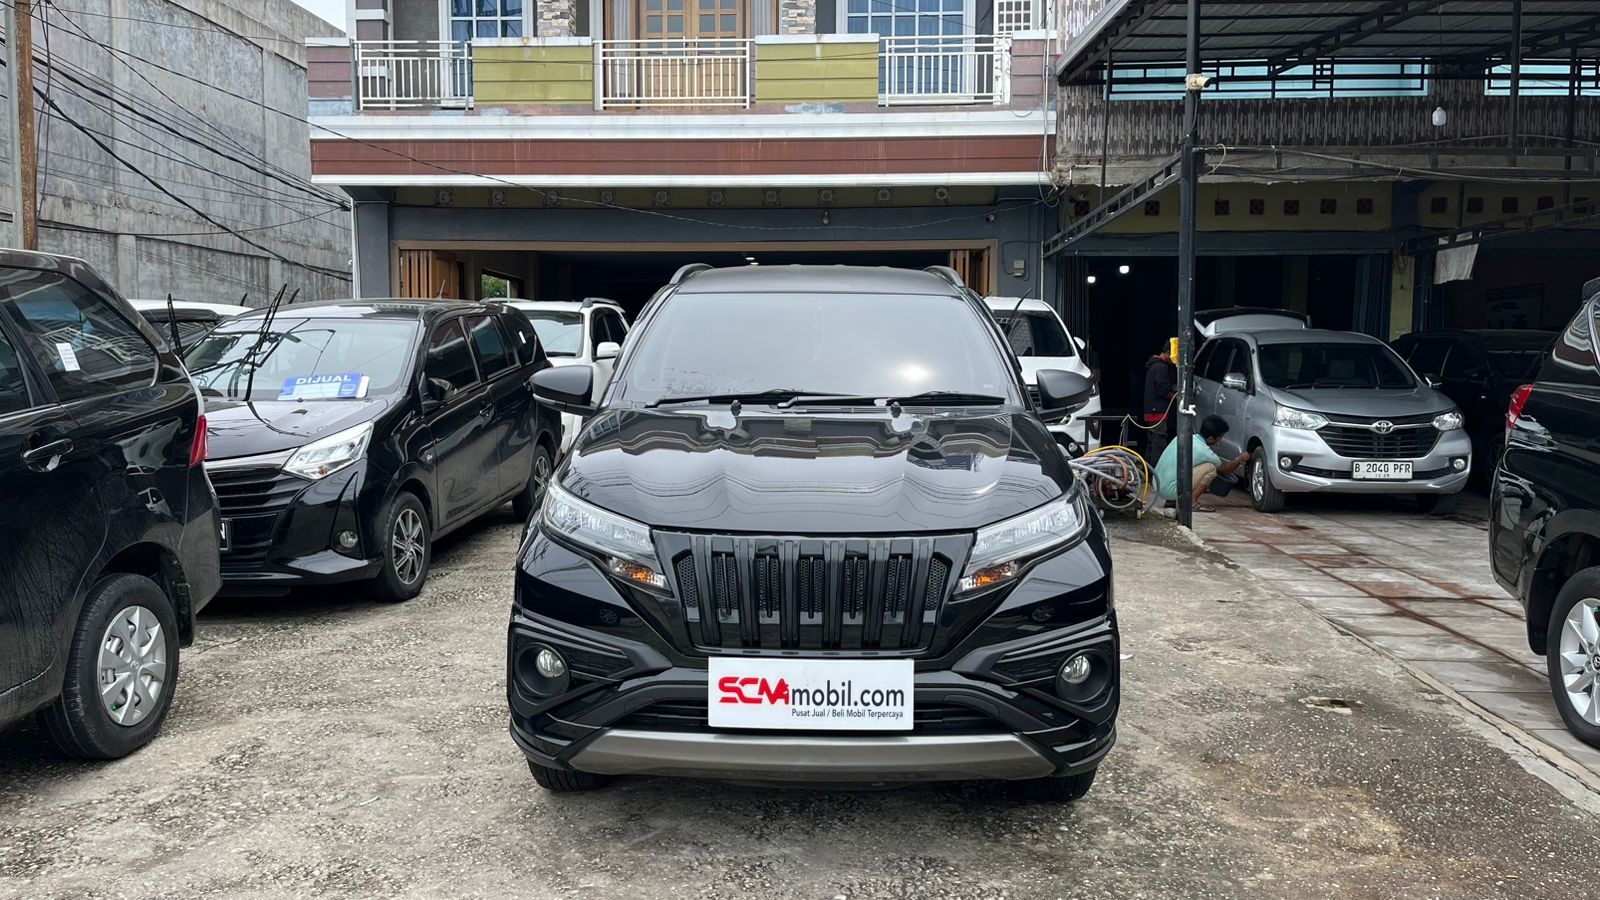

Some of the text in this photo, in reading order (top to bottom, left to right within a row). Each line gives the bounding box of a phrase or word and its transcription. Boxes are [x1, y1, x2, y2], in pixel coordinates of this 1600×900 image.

[296, 374, 352, 384] DIJUAL
[1354, 464, 1411, 473] B 2040 PFR
[791, 708, 810, 718] Pusat
[812, 708, 826, 718] Jual
[832, 709, 845, 718] Beli
[846, 709, 866, 718] Mobil
[867, 709, 904, 720] Terpercaya
